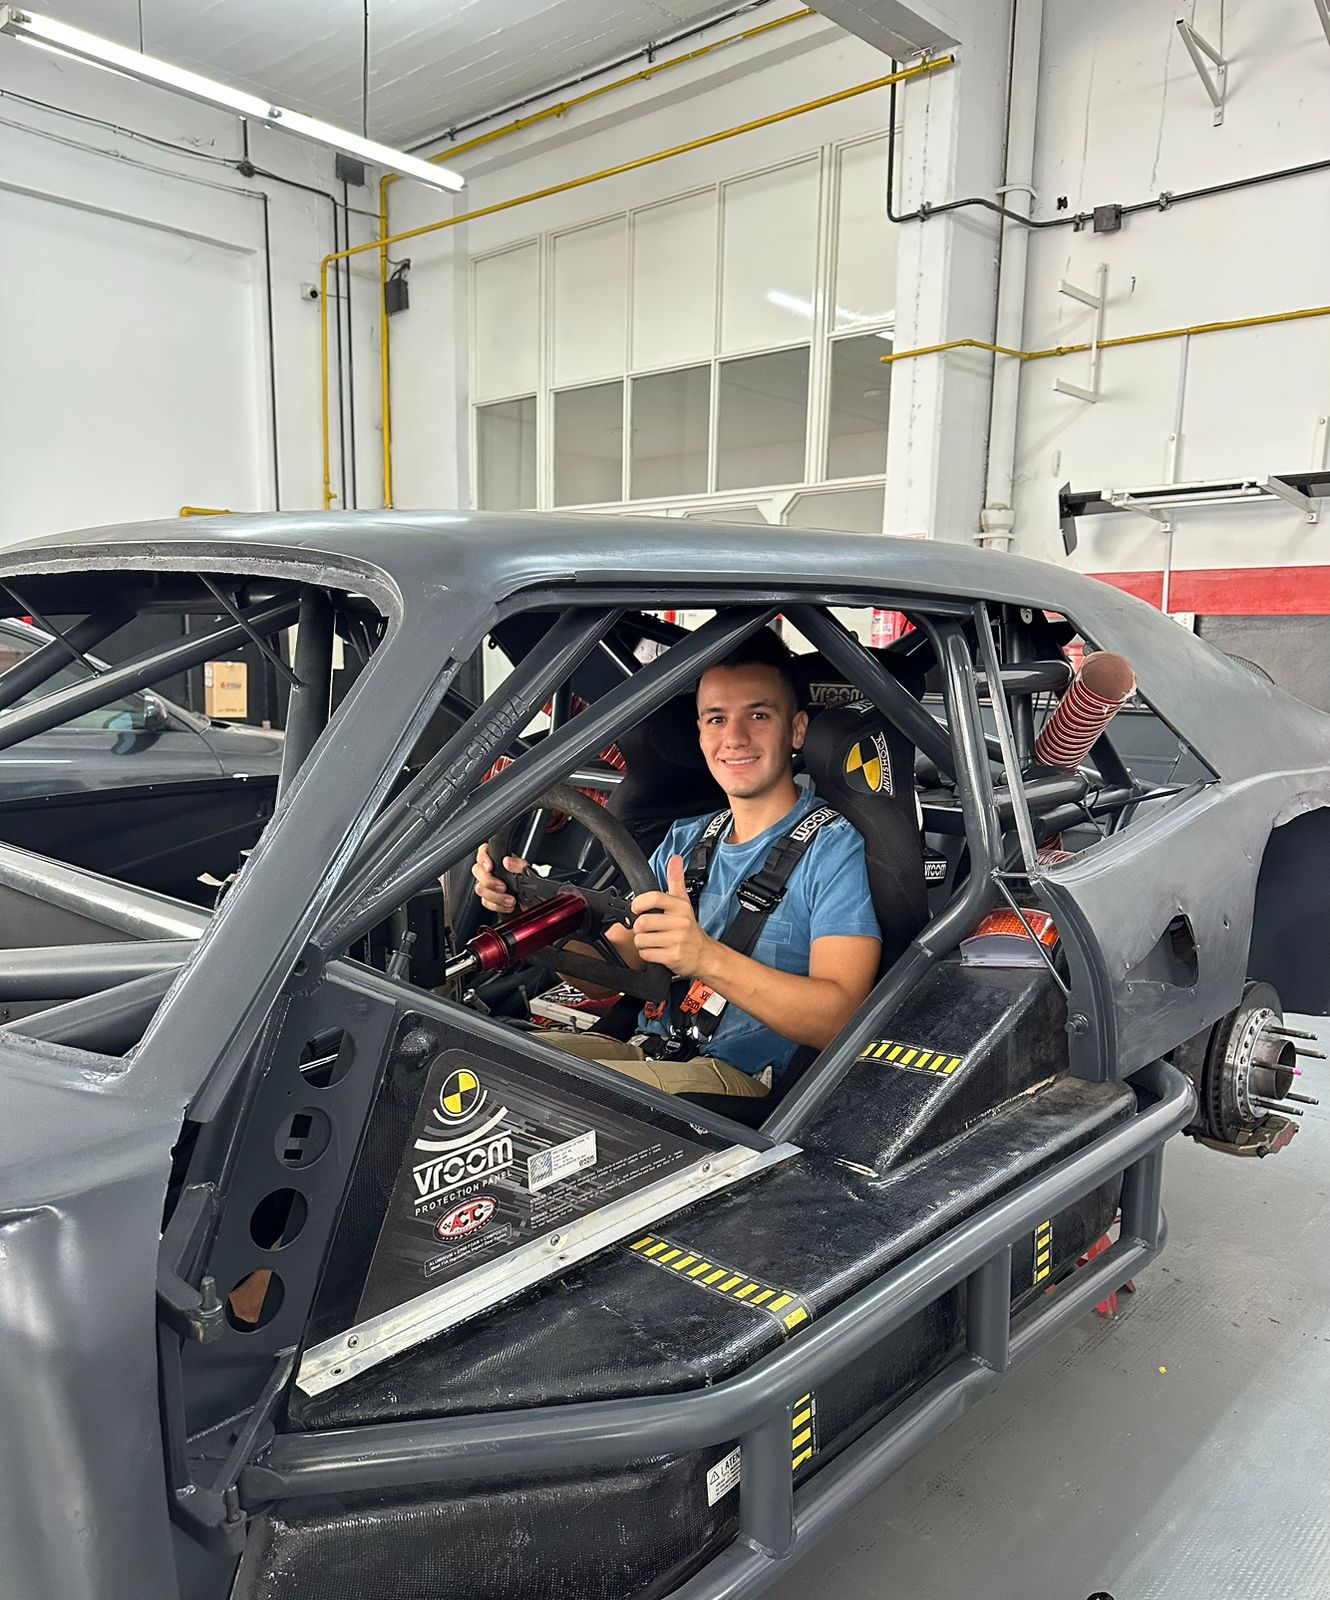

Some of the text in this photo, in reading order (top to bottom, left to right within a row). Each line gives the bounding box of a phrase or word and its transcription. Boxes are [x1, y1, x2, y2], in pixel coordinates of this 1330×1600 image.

[794, 808, 838, 841] vroom
[924, 863, 947, 877] vroom
[413, 1136, 513, 1196] vroom
[415, 1170, 512, 1217] PROTECTION PANEL
[449, 1203, 484, 1233] ACTC
